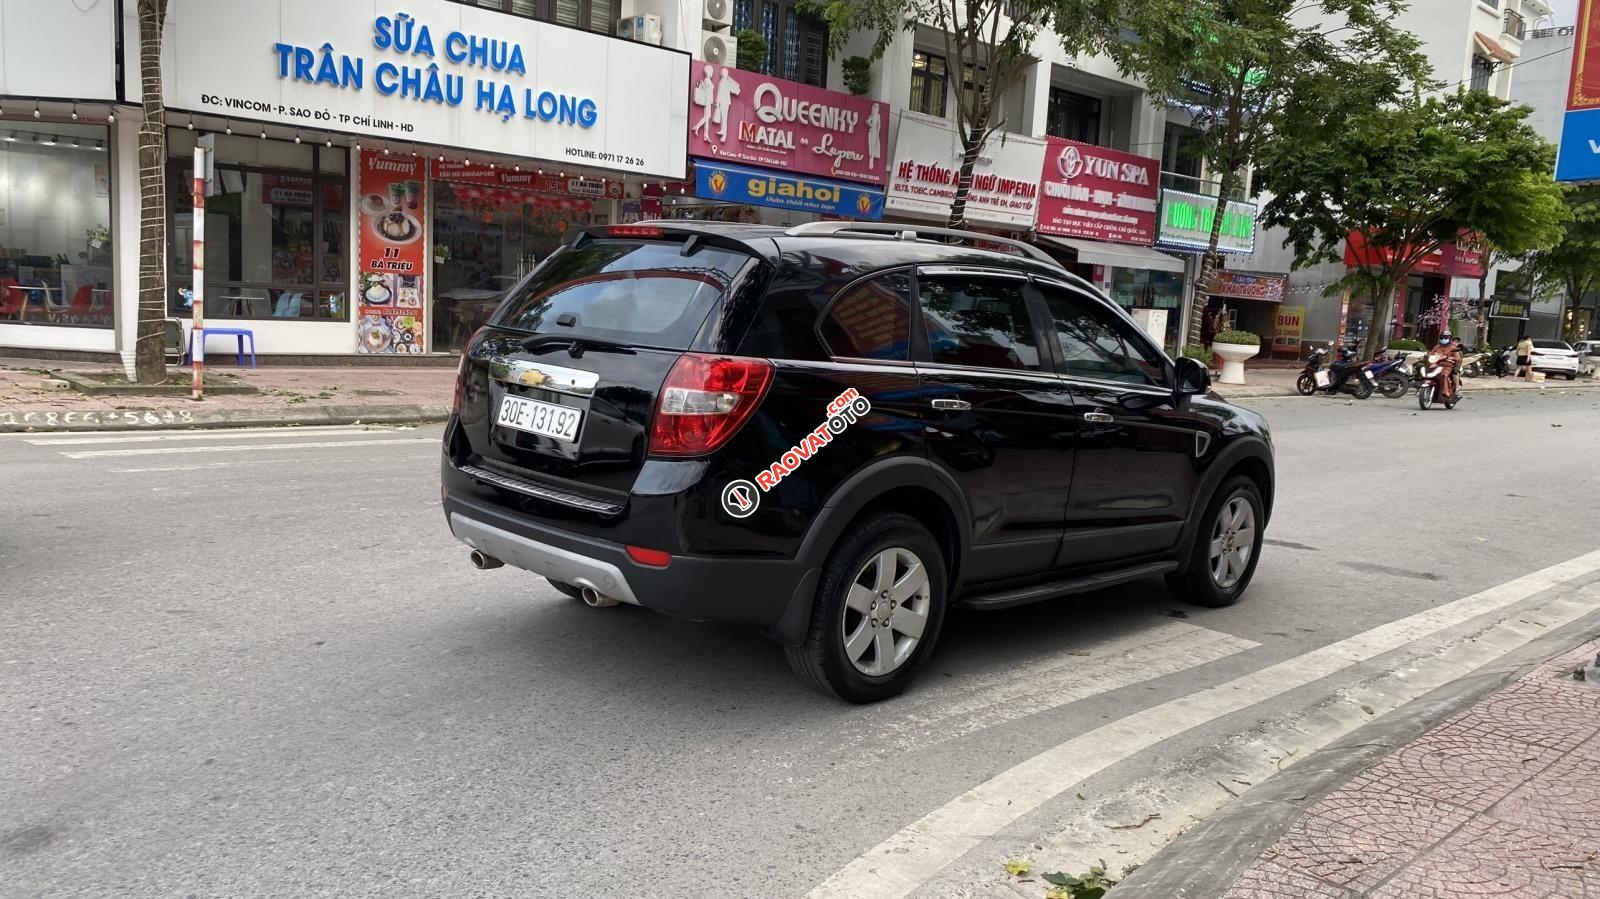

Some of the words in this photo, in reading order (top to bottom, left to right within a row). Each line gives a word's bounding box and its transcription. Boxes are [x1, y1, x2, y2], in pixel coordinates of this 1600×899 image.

[374, 12, 435, 57] SỮA
[445, 31, 527, 76] CHUA
[273, 42, 364, 91] TRÂN
[374, 62, 464, 107] CHÂU
[474, 79, 517, 123] HẠ
[523, 88, 598, 129] LONG
[201, 93, 223, 106] ĐC:
[225, 98, 271, 113] VINCOM
[278, 105, 288, 115] P.
[290, 106, 311, 118] SAO
[314, 108, 331, 121] ĐỎ
[339, 113, 350, 124] TP
[353, 114, 371, 127] CHÍ
[373, 118, 394, 130] LINH
[401, 122, 414, 133] HD
[753, 82, 859, 134] QUEENKY
[738, 120, 796, 150] MATAL
[367, 157, 417, 176] Yummy
[565, 147, 597, 160] HOTLINE:
[598, 152, 615, 163] 0971
[616, 154, 624, 164] 17
[625, 156, 634, 165] 26
[635, 158, 645, 167] 26
[1083, 155, 1121, 181] YUN
[1120, 162, 1150, 186] SPA
[501, 173, 533, 184] Yummy
[545, 181, 565, 193] 15K
[747, 176, 841, 203] giahoi
[898, 160, 914, 183] HỆ
[915, 162, 951, 186] THỐNG
[974, 173, 998, 192] NGỮ
[997, 178, 1037, 199] IMPERIA
[383, 247, 400, 258] 11
[386, 260, 413, 272] TRIỆU
[1277, 313, 1300, 327] BÚN
